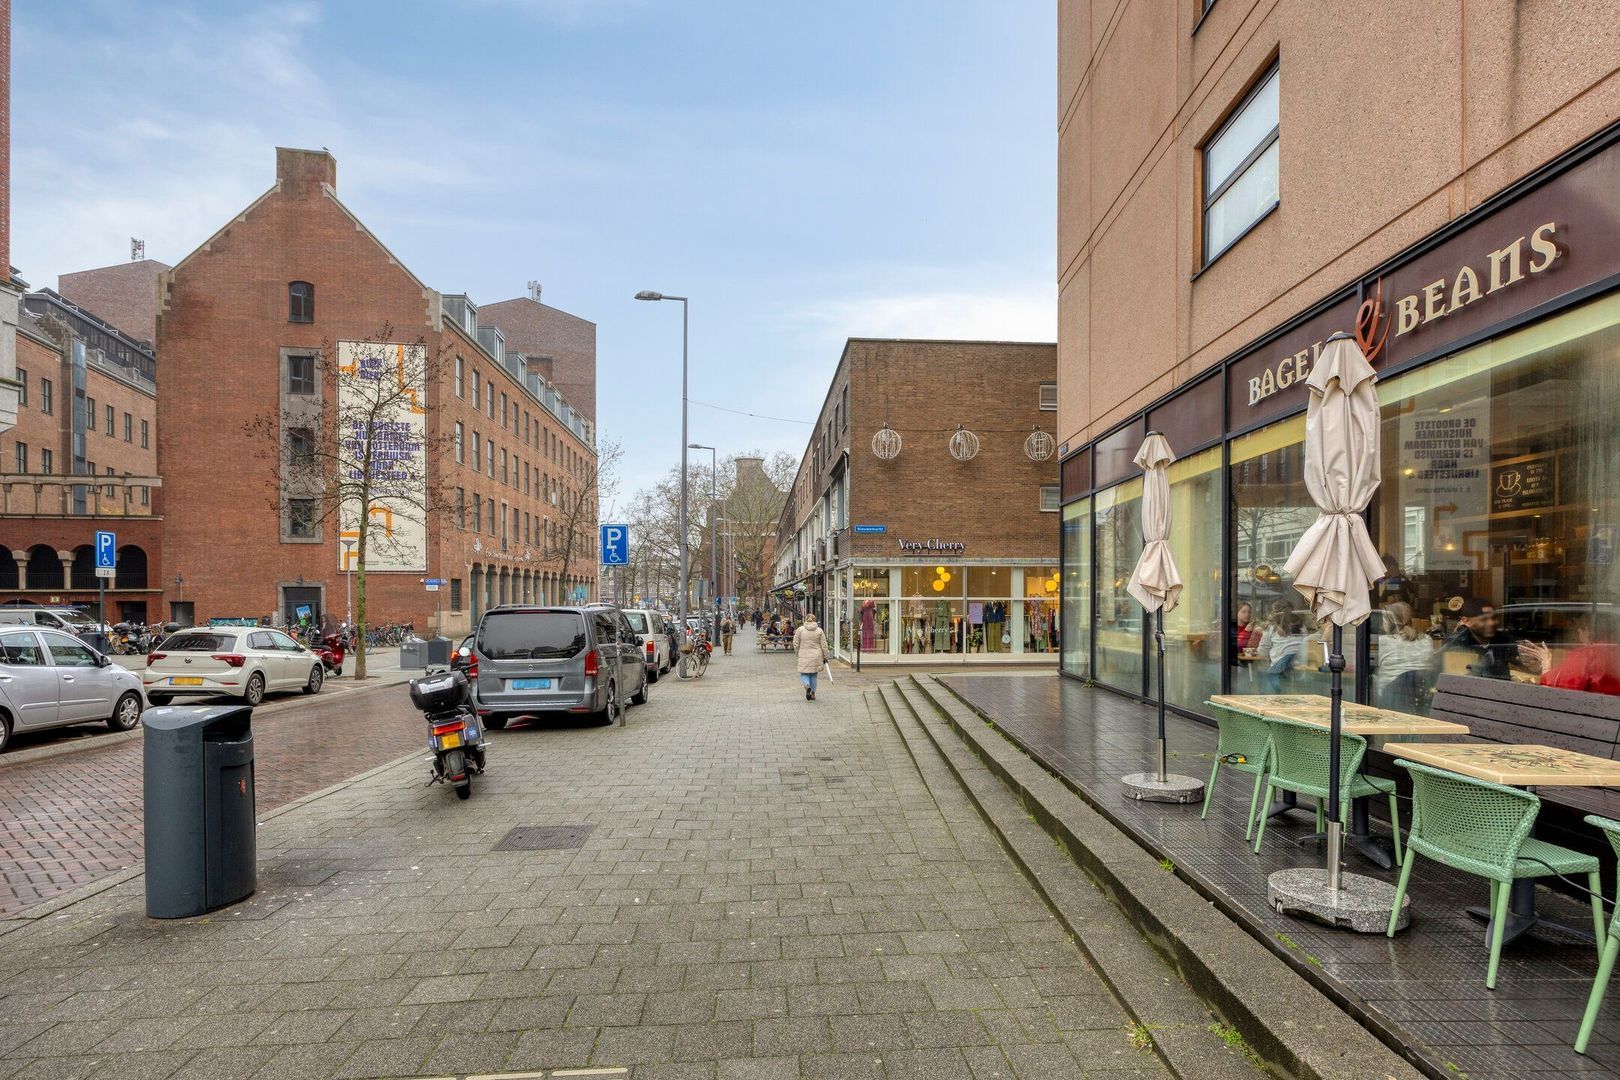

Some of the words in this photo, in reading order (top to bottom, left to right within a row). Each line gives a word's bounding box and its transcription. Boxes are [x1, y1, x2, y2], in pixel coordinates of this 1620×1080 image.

[1248, 342, 1323, 407] BAGE
[366, 420, 411, 432] ROOTSTE
[371, 441, 420, 451] OTTERDAM
[101, 534, 112, 553] P
[898, 538, 923, 553] Very
[927, 538, 965, 553] Cherry
